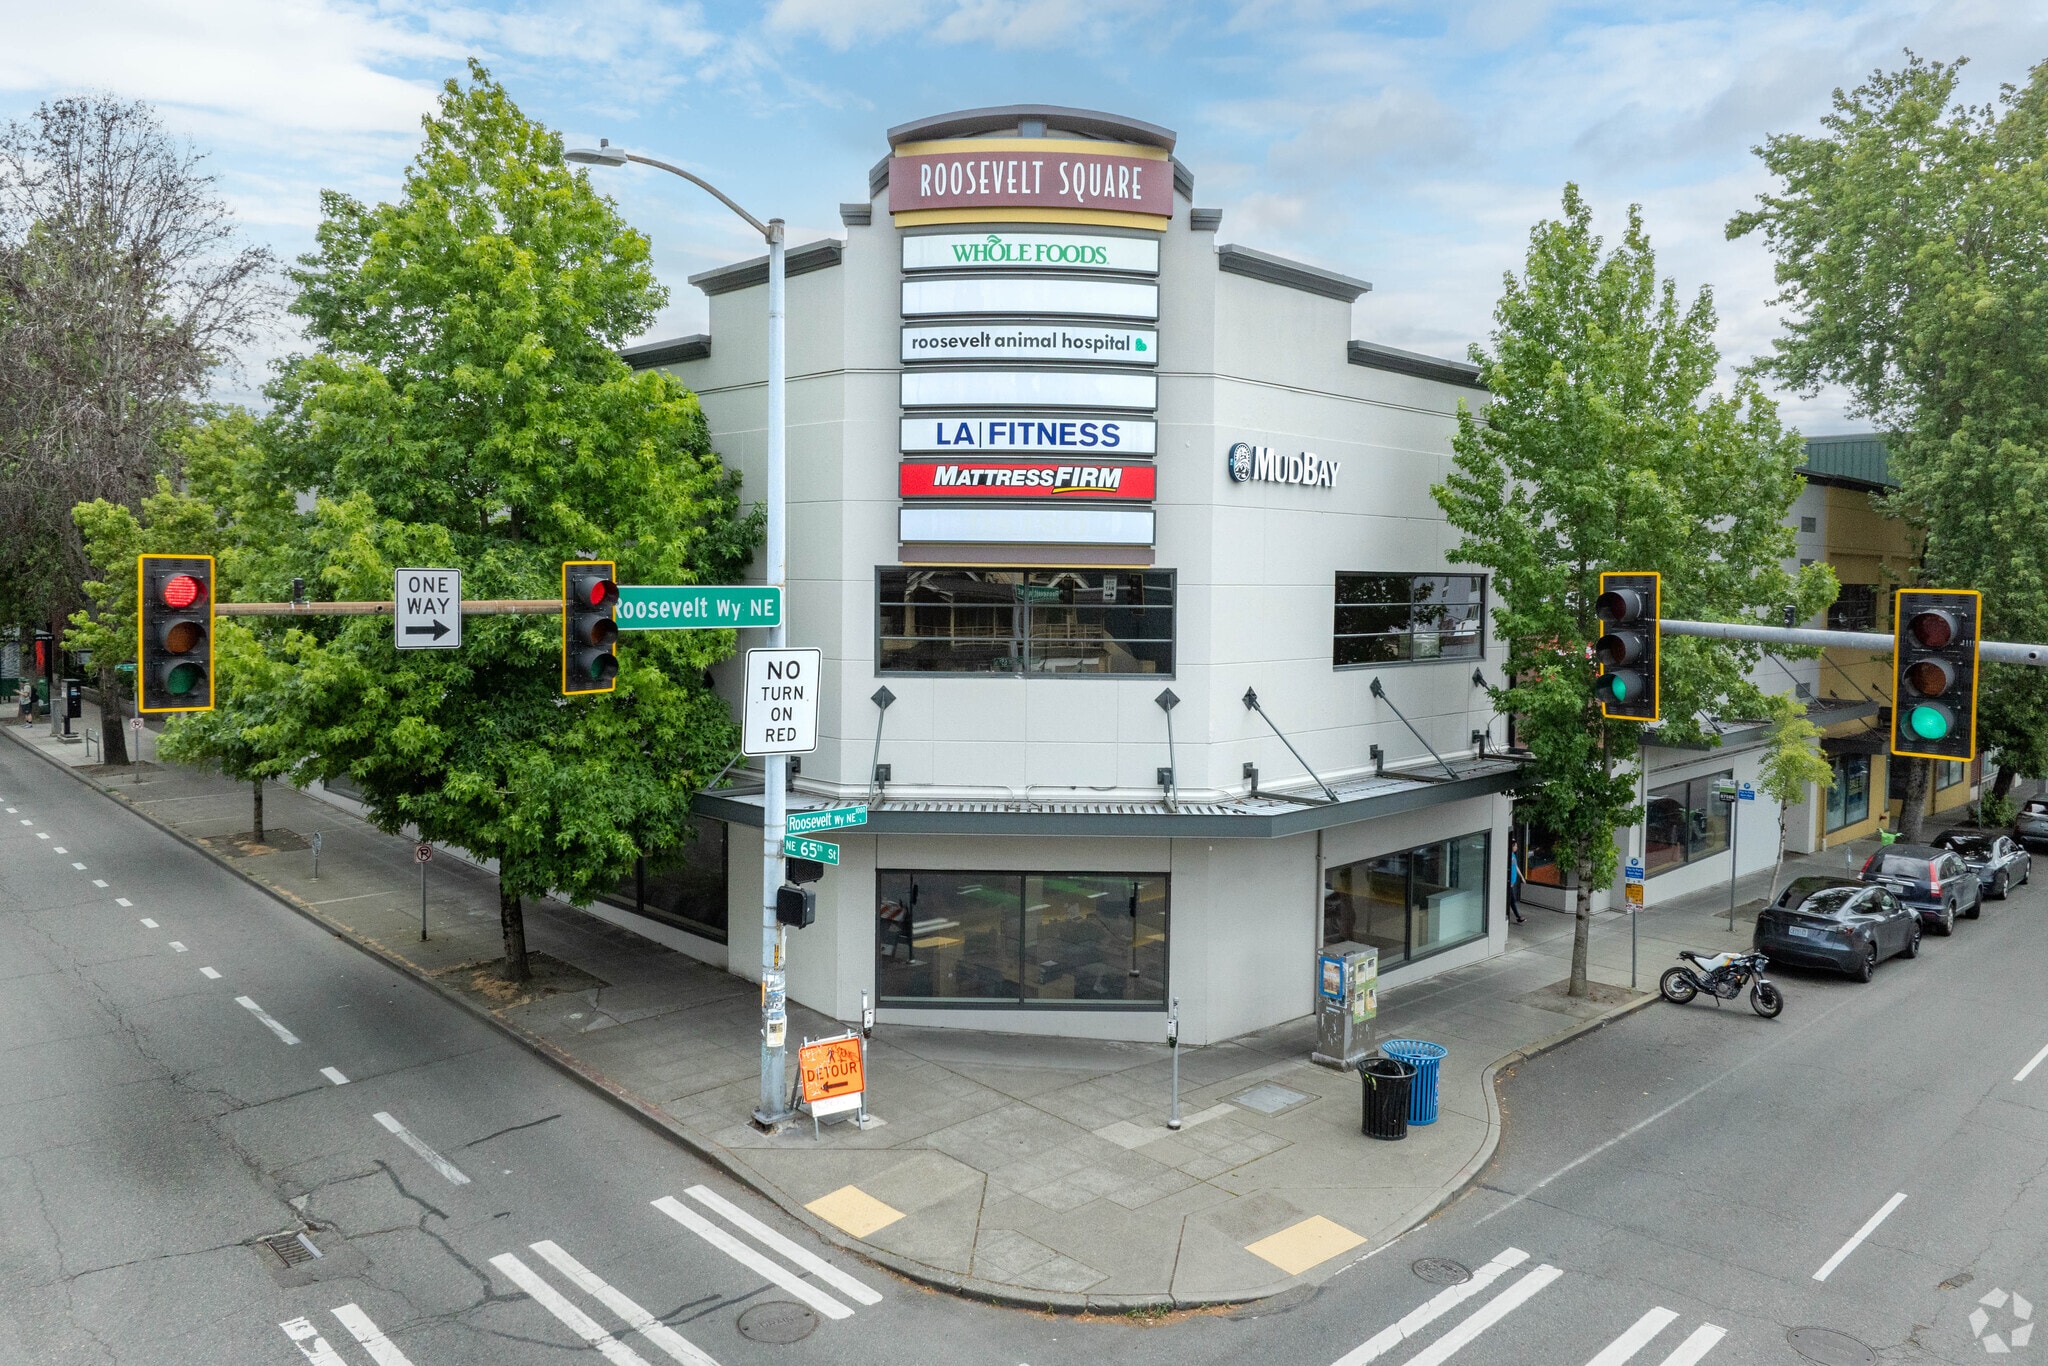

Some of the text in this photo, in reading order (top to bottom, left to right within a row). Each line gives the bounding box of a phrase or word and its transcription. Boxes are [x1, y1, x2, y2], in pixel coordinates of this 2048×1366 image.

[920, 160, 1142, 203] ROOSEVELT SQUARE
[952, 236, 1107, 265] WHOLE FOODS
[912, 332, 1130, 353] roosevelt animal hospital
[936, 422, 1121, 448] LA FITNESS
[408, 576, 449, 593] ONE
[407, 597, 450, 615] WAY
[616, 597, 774, 621] Roosevelt Wy NE
[767, 660, 801, 680] NO
[761, 686, 804, 701] TURN
[771, 707, 793, 722] ON
[765, 727, 797, 743] RED
[789, 813, 856, 831] Roosevelt Wy NE
[785, 840, 796, 851] NE
[828, 849, 837, 860] St
[807, 1061, 857, 1082] DETOUR
